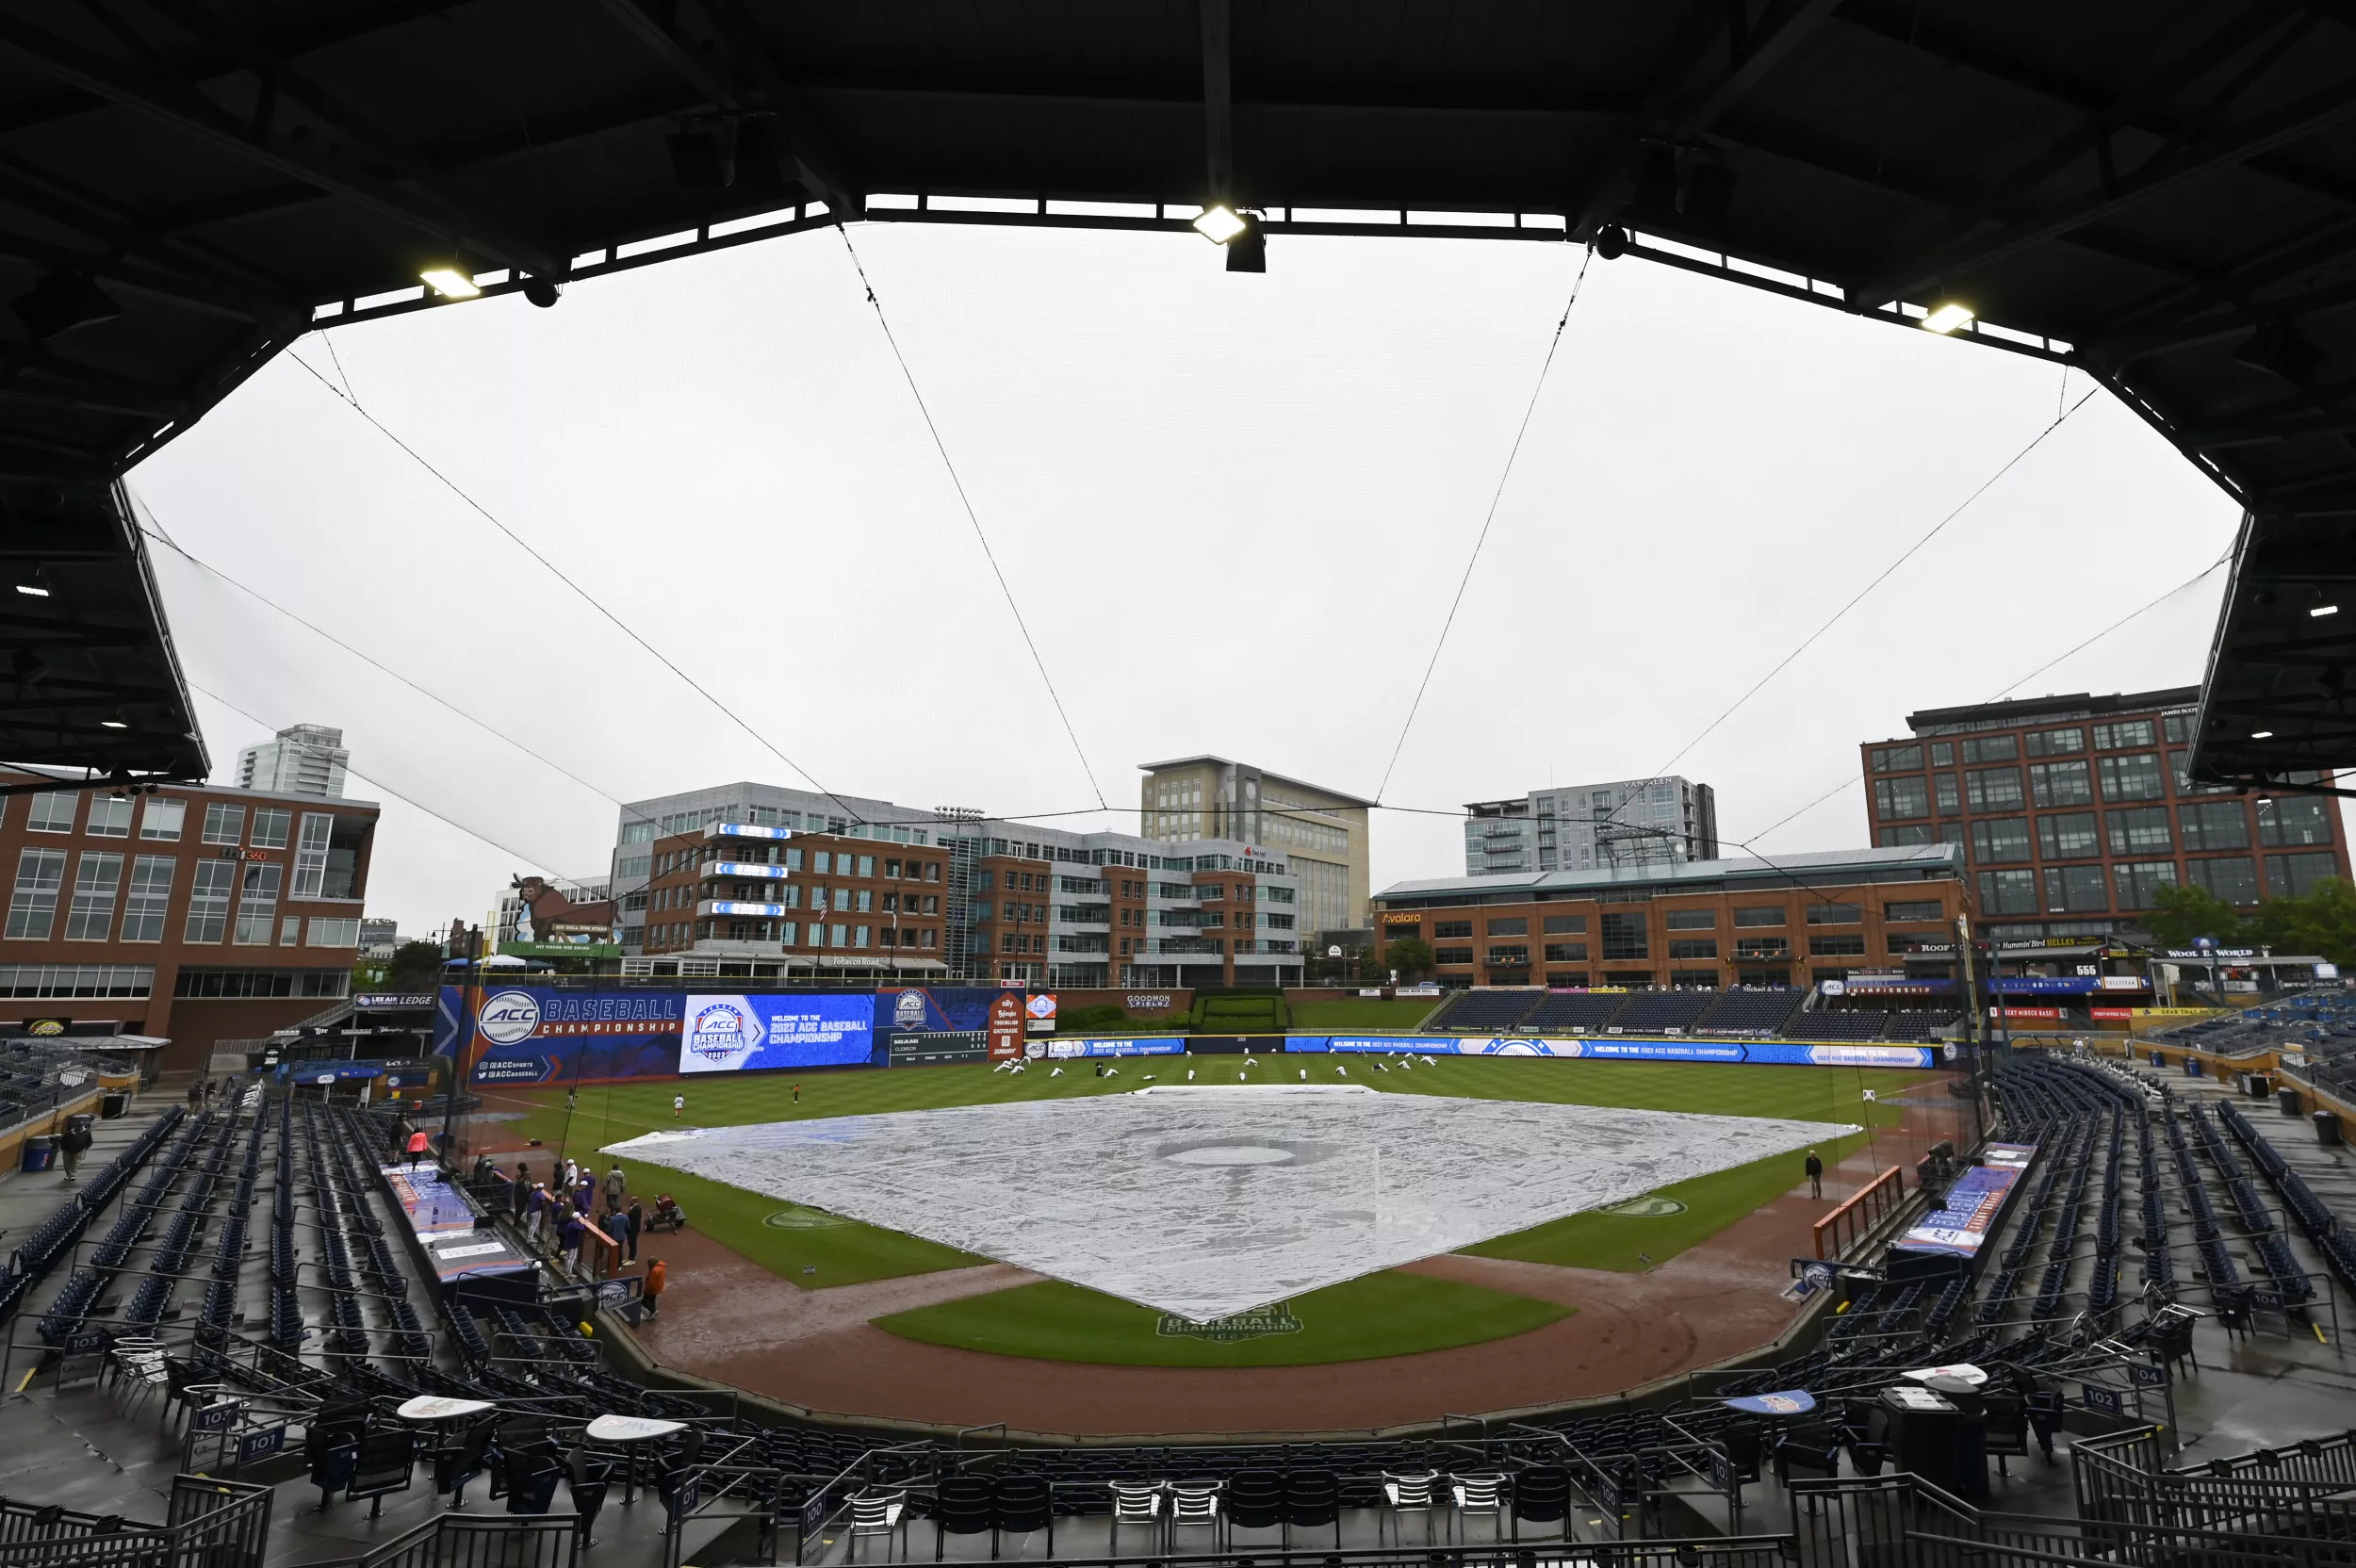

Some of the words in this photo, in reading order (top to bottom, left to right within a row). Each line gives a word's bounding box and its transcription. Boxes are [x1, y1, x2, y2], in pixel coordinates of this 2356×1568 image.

[1383, 912, 1421, 923] Avalara
[2047, 938, 2075, 947] HELLES
[400, 996, 432, 1004] LEDGE
[1002, 1000, 1013, 1008] ally
[488, 1009, 537, 1021] ACC
[544, 999, 677, 1021] BASEBALL
[896, 1010, 924, 1018] BASEBALL
[543, 1022, 676, 1034] CHAMPIONSHIP
[770, 1022, 795, 1033] 2023
[798, 1022, 818, 1032] ACC
[820, 1021, 867, 1031] BASEBALL
[694, 1033, 743, 1043] BASEBALL
[769, 1032, 842, 1044] CHAMPIONSHIP
[603, 1292, 624, 1300] ACC
[2255, 1295, 2278, 1304] 104
[1167, 1324, 1295, 1332] CHAMPIONSHIP
[73, 1337, 98, 1348] 103
[2139, 1369, 2158, 1382] 04
[2088, 1390, 2113, 1406] 102
[251, 1434, 276, 1451] 101
[1715, 1463, 1727, 1481] 10
[684, 1488, 694, 1505] 01
[1602, 1485, 1616, 1506] 100
[807, 1502, 822, 1524] 100
